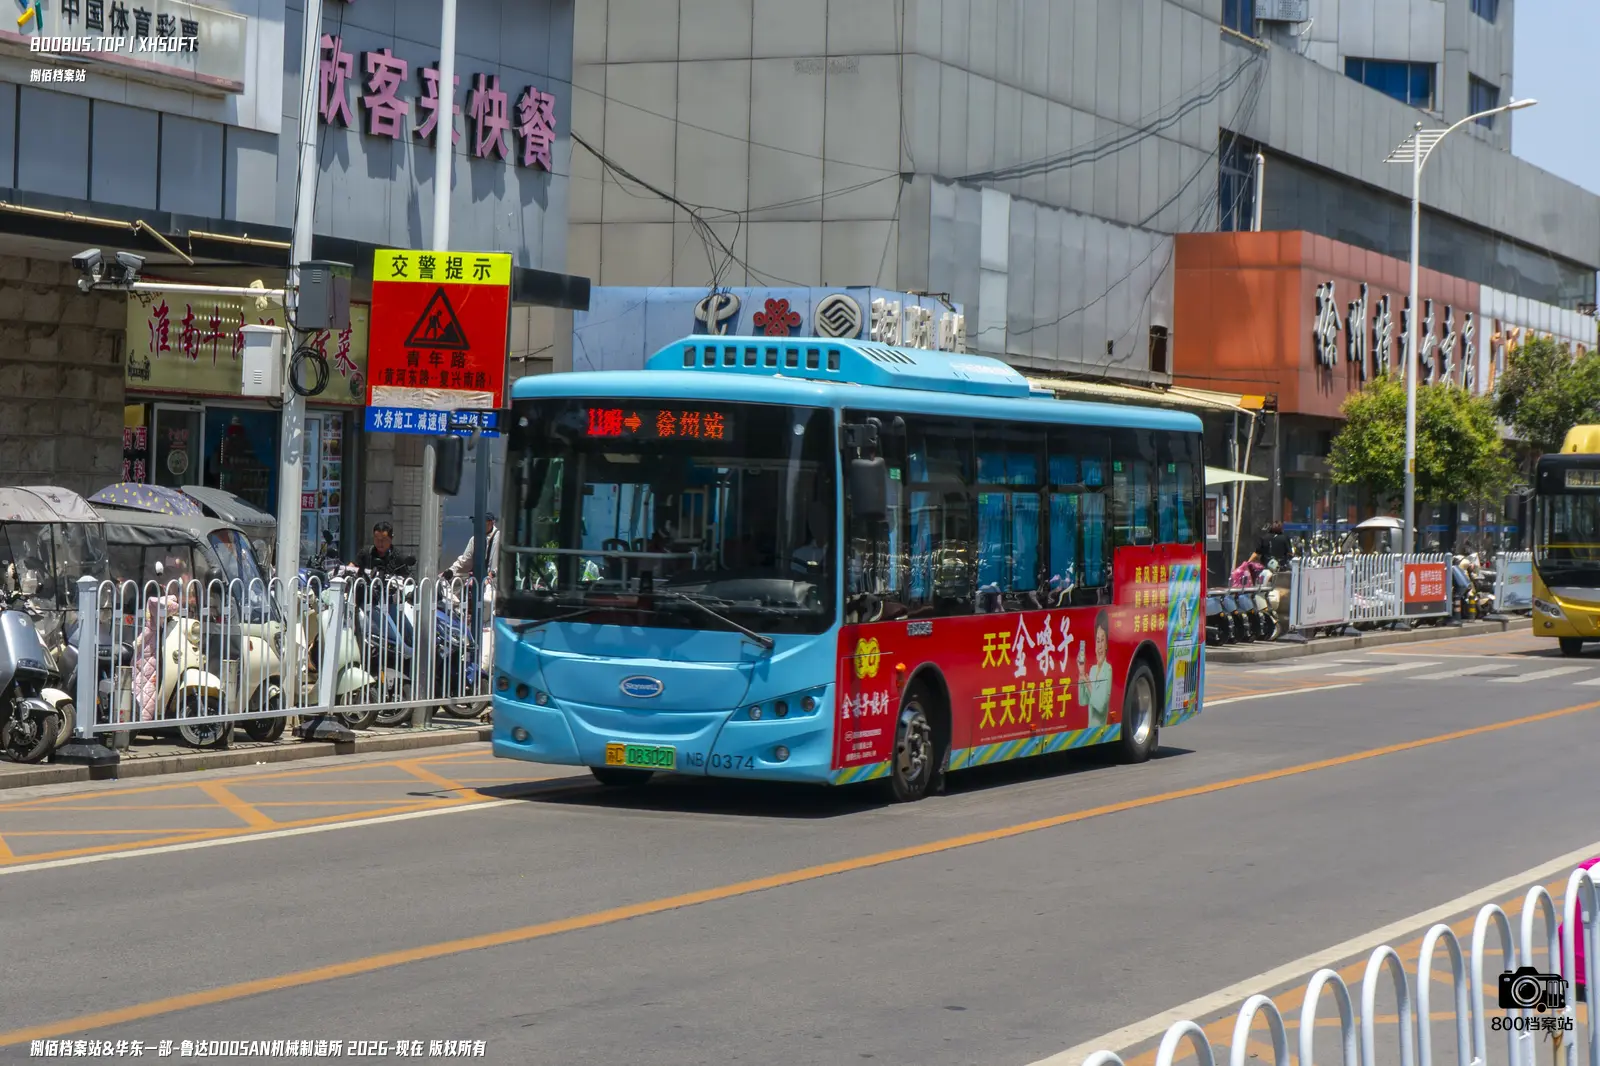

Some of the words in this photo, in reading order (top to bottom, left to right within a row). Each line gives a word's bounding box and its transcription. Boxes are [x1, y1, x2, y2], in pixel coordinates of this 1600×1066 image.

[391, 255, 492, 281] 交警提示
[406, 351, 467, 369] 青年路
[656, 410, 725, 439] 徐州站
[979, 677, 1073, 730] 天天好嗓子
[711, 753, 755, 770] 0374
